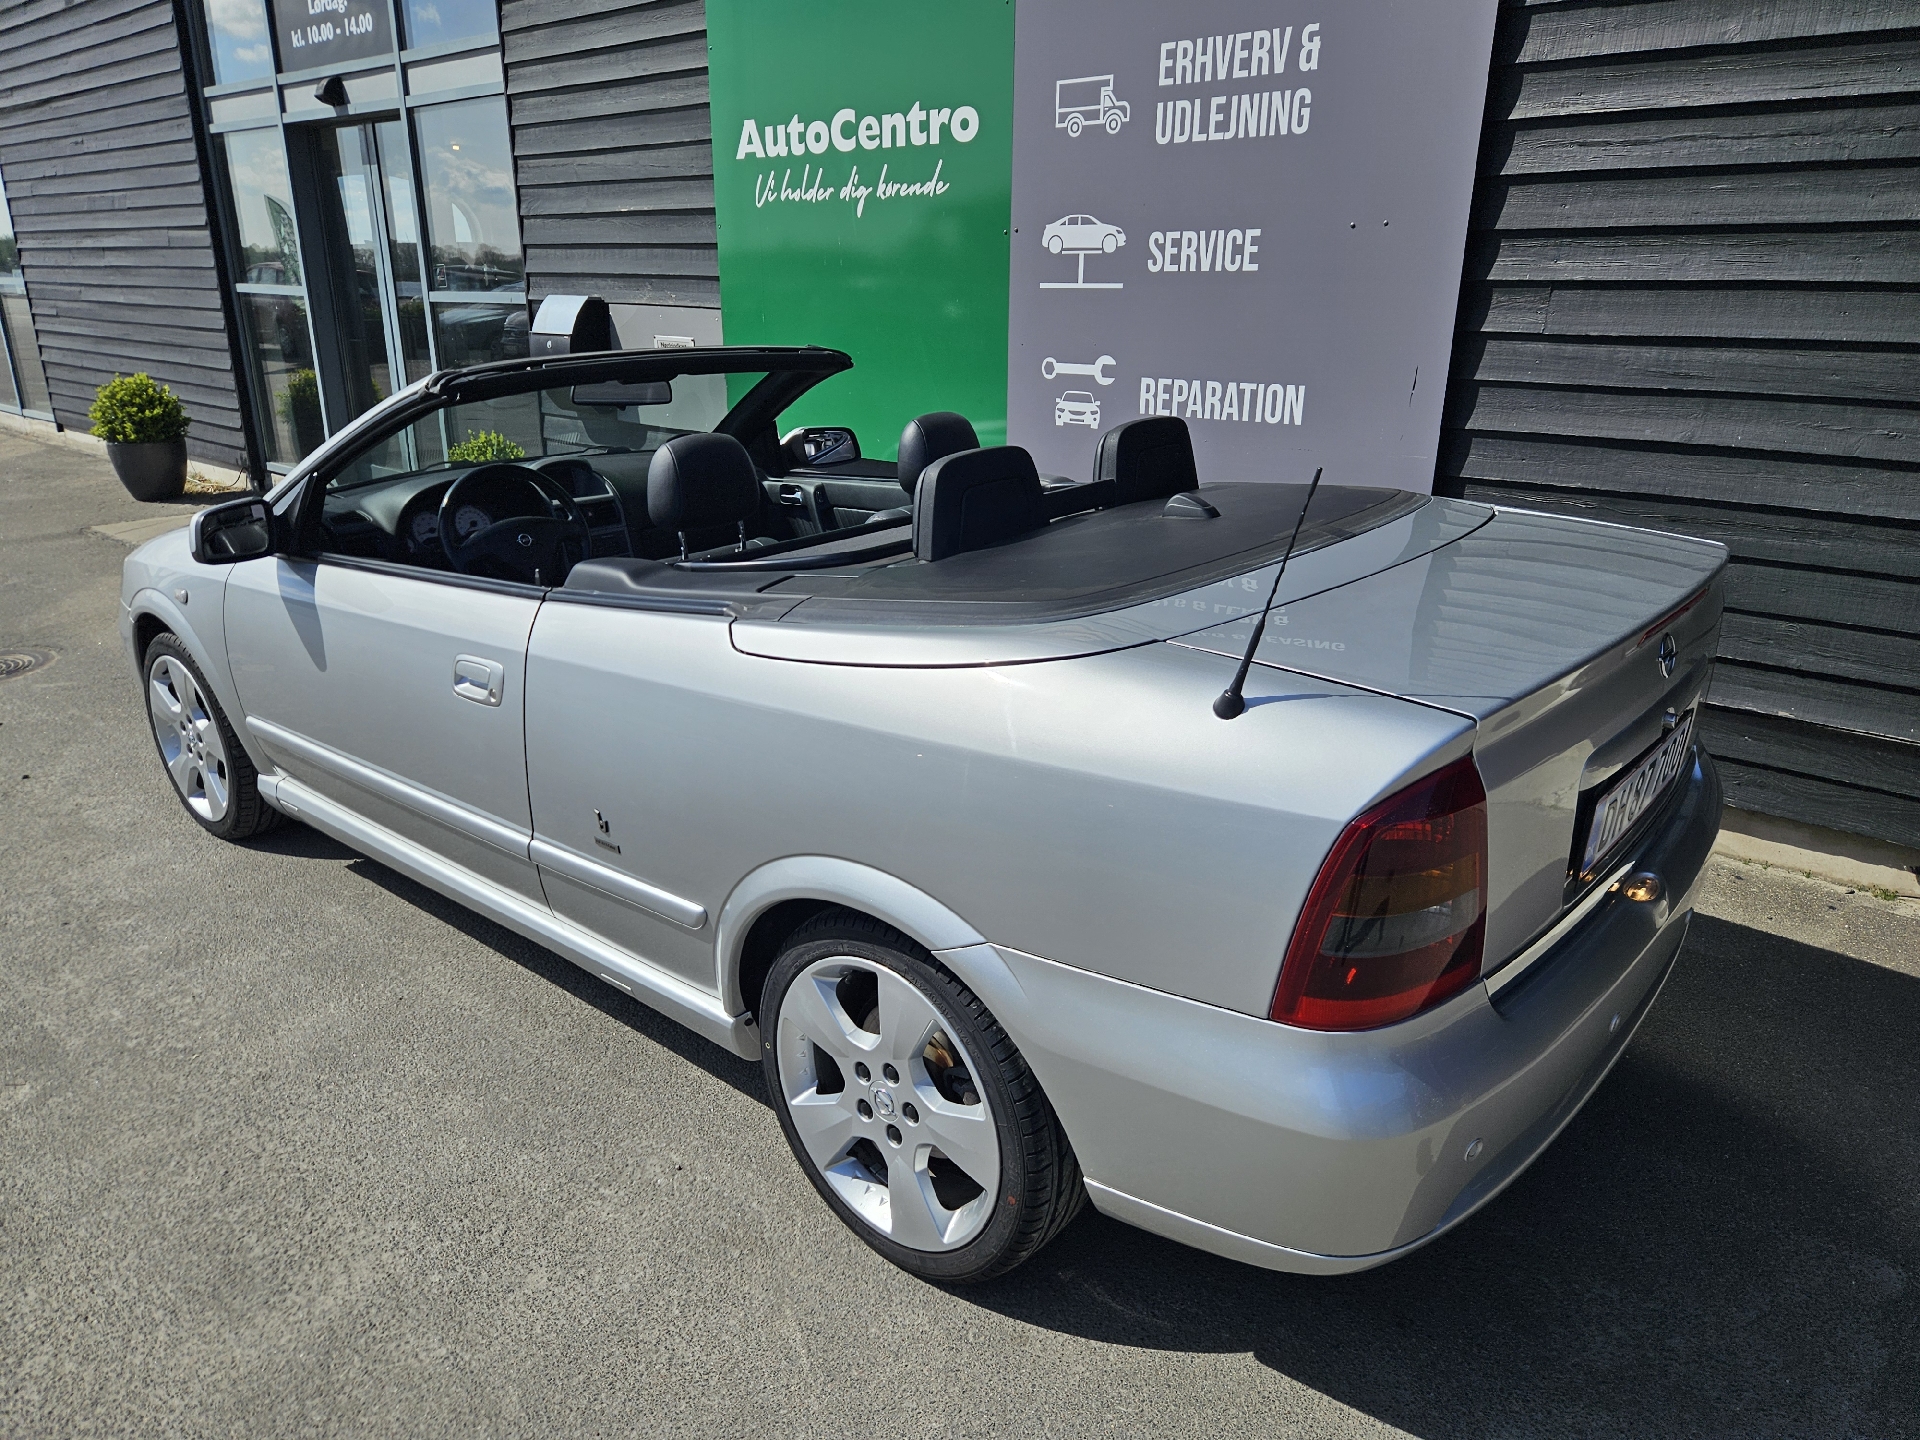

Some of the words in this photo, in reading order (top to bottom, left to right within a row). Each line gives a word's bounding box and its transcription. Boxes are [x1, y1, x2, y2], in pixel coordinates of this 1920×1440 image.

[291, 29, 306, 48] kl.
[307, 22, 334, 45] 10.00
[344, 12, 373, 36] 14.00
[1158, 26, 1292, 86] ERHVERV
[1299, 23, 1321, 72] &
[735, 101, 980, 160] AutoCentro
[1155, 87, 1312, 145] UDLEJNING
[755, 170, 777, 208] Vi
[780, 163, 835, 203] holder
[839, 165, 873, 218] dig
[1147, 228, 1262, 273] SERVICE
[1139, 376, 1306, 426] REPARATION
